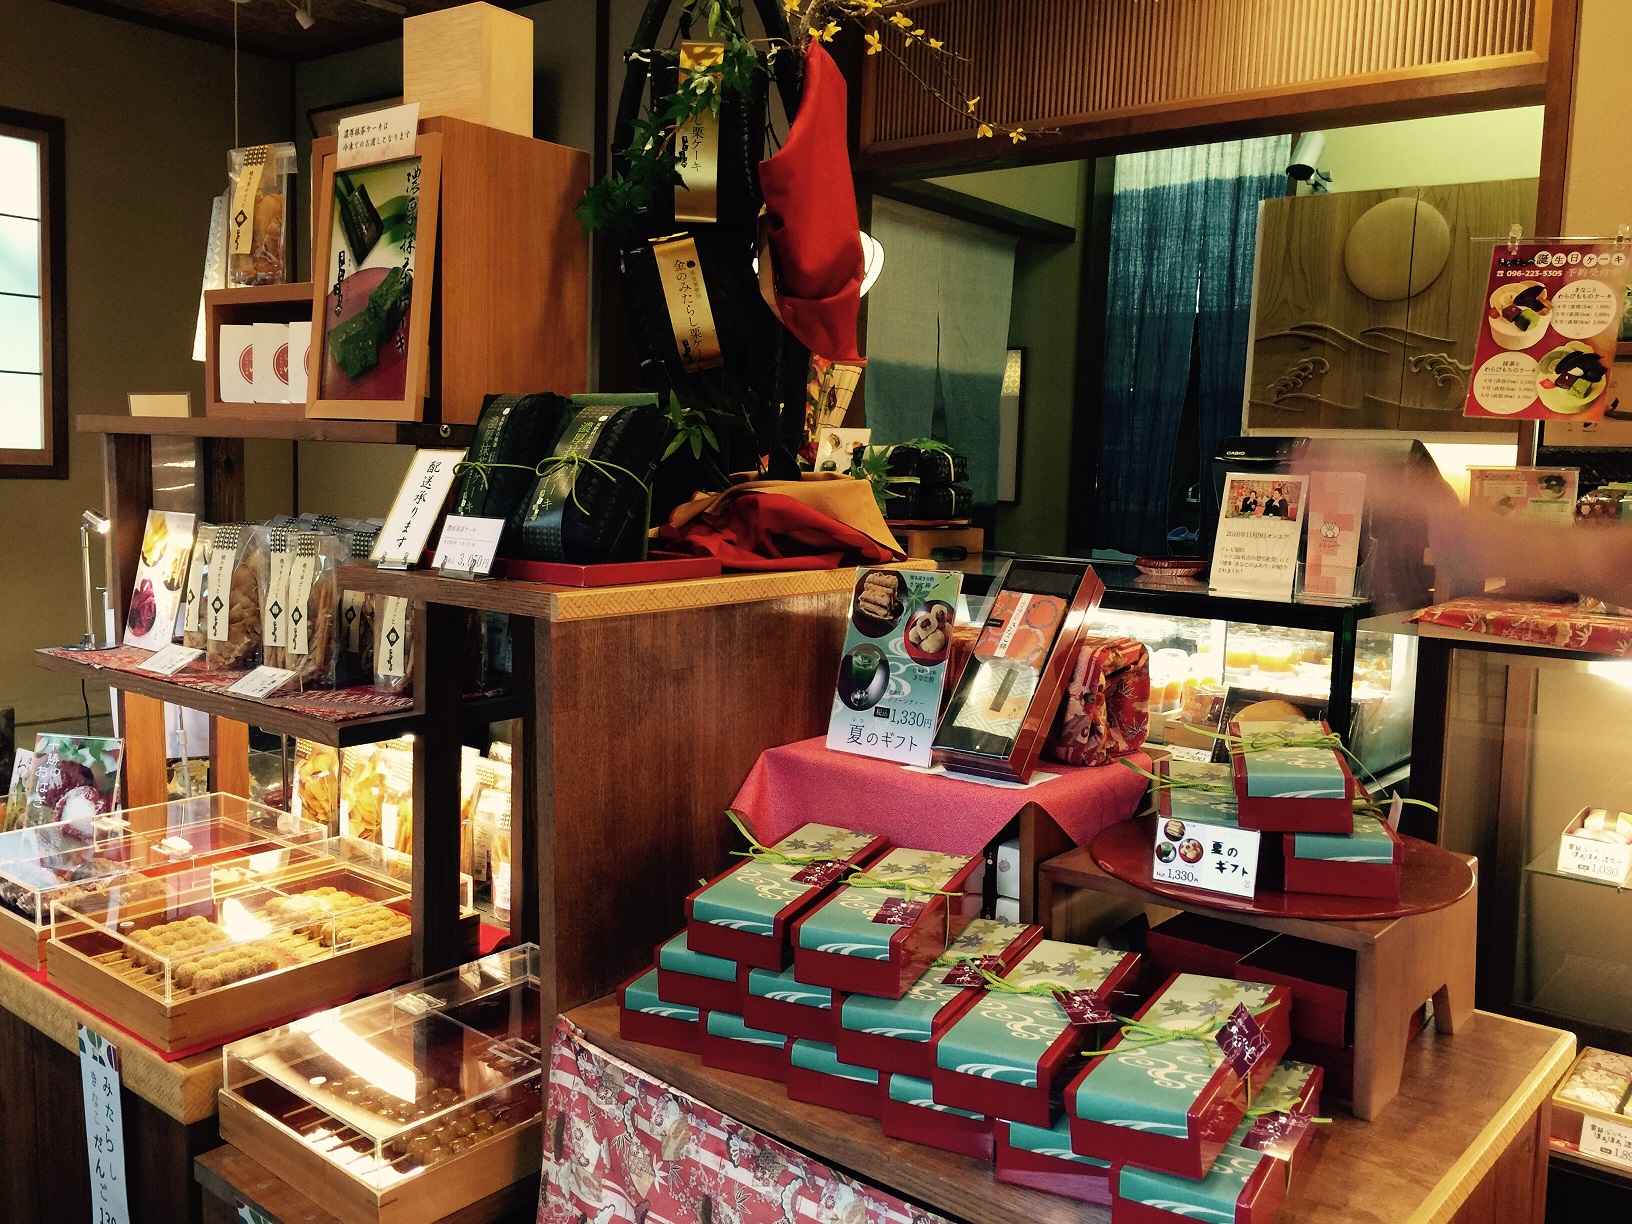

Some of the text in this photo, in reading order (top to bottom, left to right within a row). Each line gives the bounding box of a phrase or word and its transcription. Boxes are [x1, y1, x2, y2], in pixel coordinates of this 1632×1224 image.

[541, 421, 594, 511] 濃厚抹ケーキ
[396, 460, 443, 550] 配送承ります
[890, 708, 933, 729] 1,330円
[846, 724, 918, 752] 夏のギフト
[1210, 840, 1239, 858] 夏の
[1214, 859, 1249, 877] ギフト
[102, 1076, 117, 1181] みたらし
